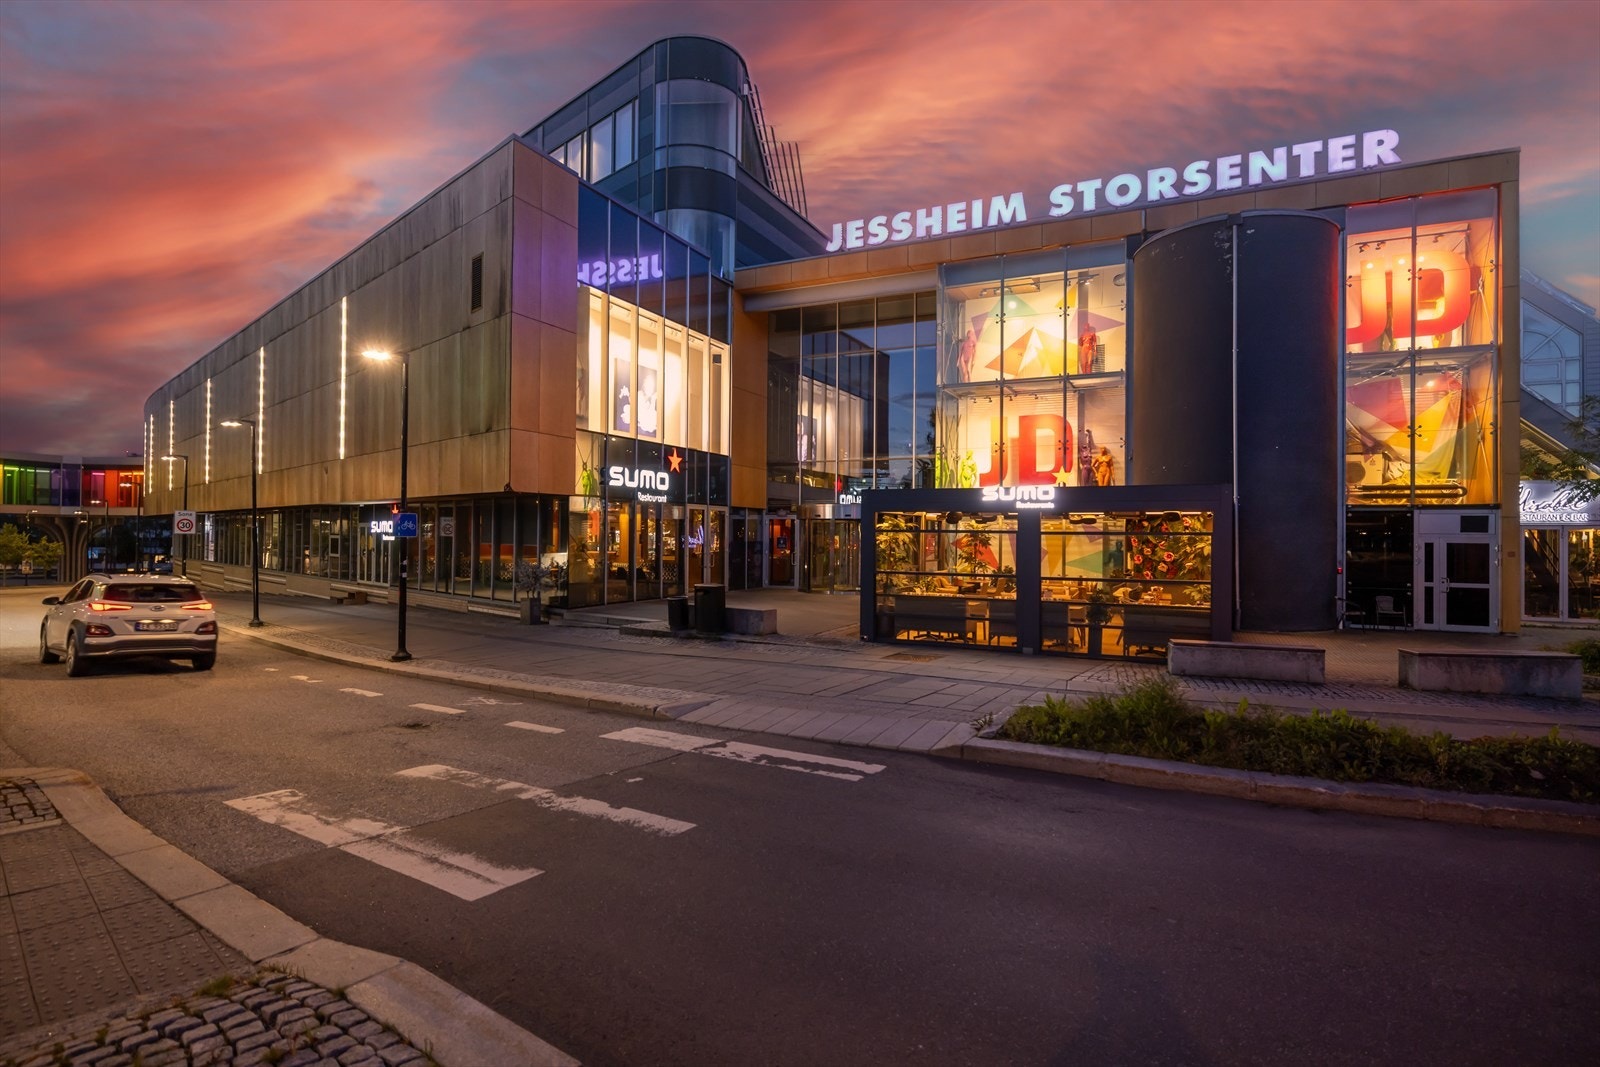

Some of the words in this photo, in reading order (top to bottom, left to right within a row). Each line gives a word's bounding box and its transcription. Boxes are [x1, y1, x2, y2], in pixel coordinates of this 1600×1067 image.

[826, 191, 1027, 252] JESSHEIM
[1049, 129, 1401, 217] STORSENTER
[1346, 251, 1471, 345] JD
[979, 414, 1074, 486] JD
[609, 466, 669, 491] SUMO
[638, 492, 667, 503] Restaurant
[982, 486, 1055, 501] SUMO
[371, 521, 393, 533] SUMO
